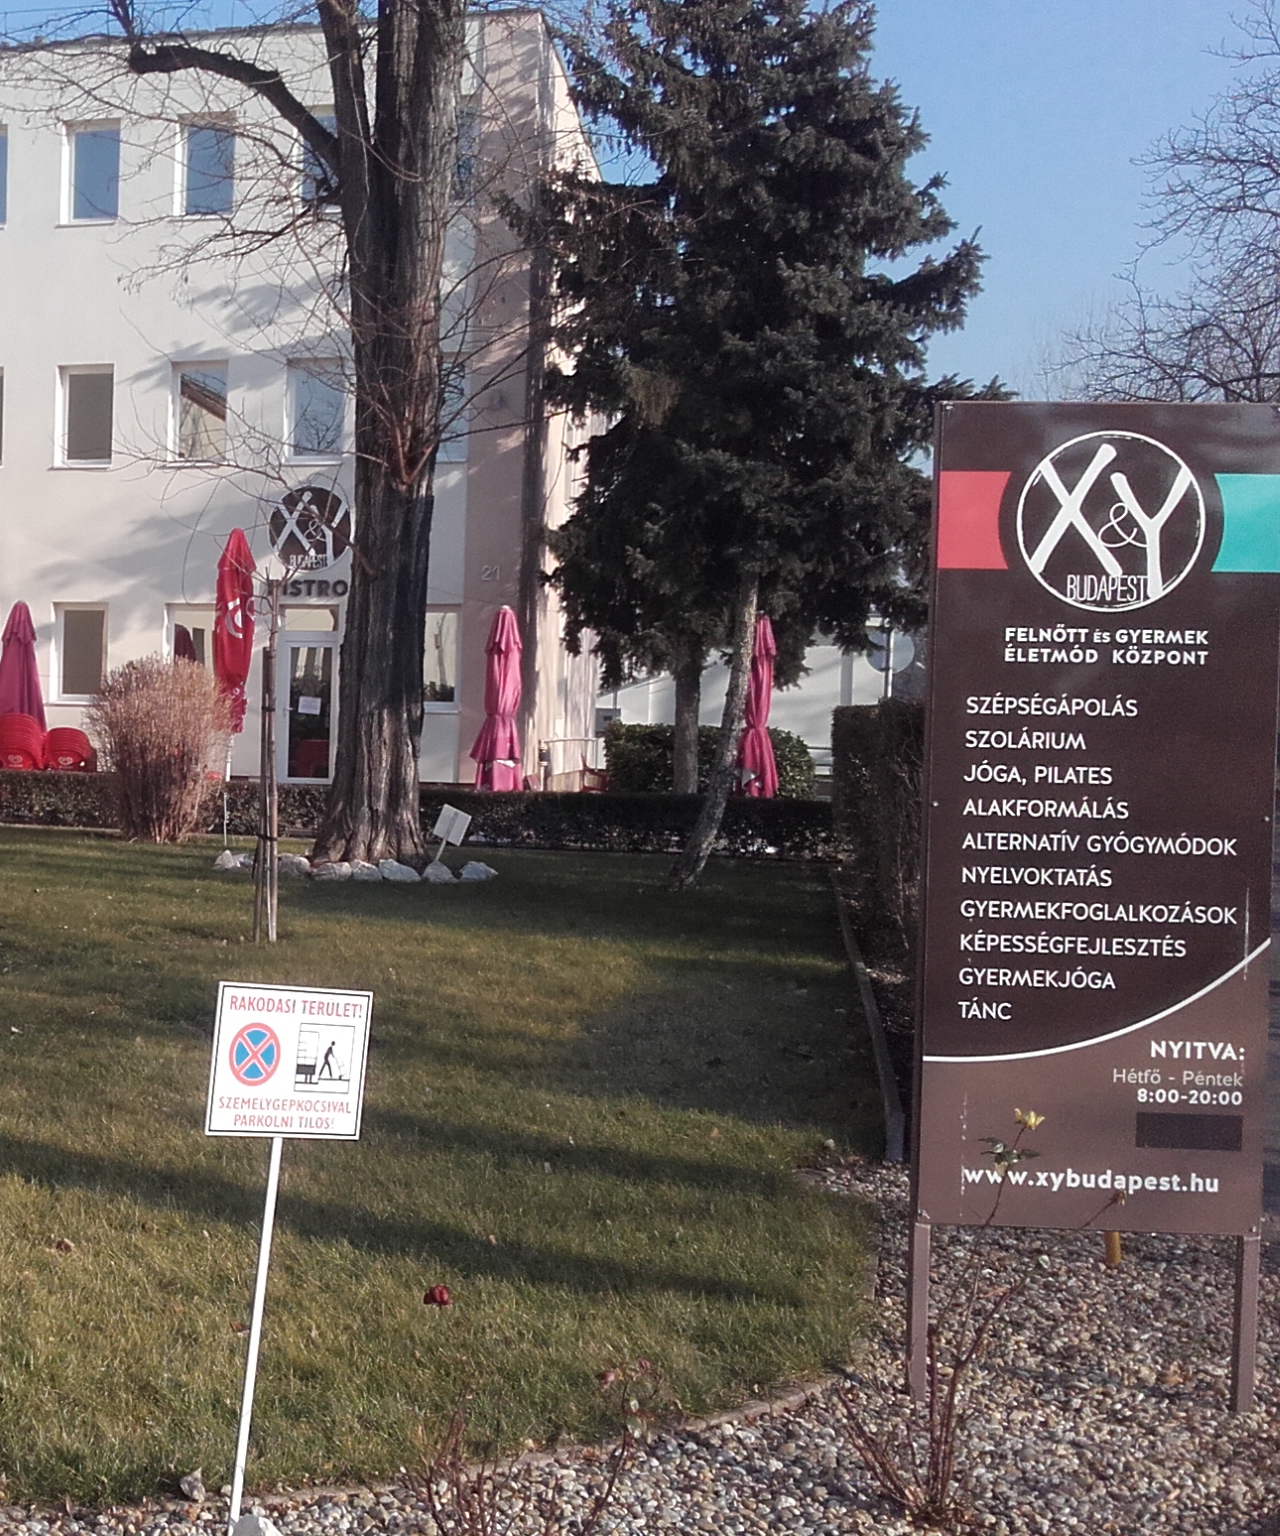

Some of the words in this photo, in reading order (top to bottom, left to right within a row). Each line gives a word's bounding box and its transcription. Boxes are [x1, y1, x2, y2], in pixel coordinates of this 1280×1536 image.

[481, 565, 500, 580] 21
[1066, 573, 1148, 602] BUDAPEST
[1005, 623, 1090, 643] FELNŐTT
[1115, 629, 1209, 645] GYERMEK
[1004, 642, 1099, 664] ÉLETMÓD
[1112, 645, 1209, 665] KÖZPONT
[966, 691, 1138, 717] SZÉPSÉGÁPOLÁS
[965, 726, 1087, 750] SZOLÁRIUM
[963, 759, 1027, 786] JÓGA,
[1034, 765, 1113, 785] PILATES
[962, 795, 1129, 820] ALAKFORMÁLÁS
[961, 829, 1081, 852] ALTERNATÍV
[1086, 830, 1237, 856] GYÓGYMÓDOK
[961, 864, 1113, 887] NYELVOKTATÁS
[960, 899, 1237, 925] GYERMEKFOGLALKOZÁSOK
[960, 929, 1187, 958] KÉPESSÉGFEJLESZTÉS
[958, 965, 1116, 990] GYERMEKJÓGA
[957, 996, 1012, 1020] TÁNC
[1150, 1040, 1245, 1061] NYITVA:
[1113, 1067, 1162, 1085] Hétfő
[1182, 1070, 1243, 1087] Péntek
[1137, 1087, 1243, 1106] 8:00-20:00
[233, 1114, 293, 1128] PARKOLNI
[298, 1116, 335, 1130] TILOS!
[962, 1167, 1219, 1195] www.xybudapest.hu
